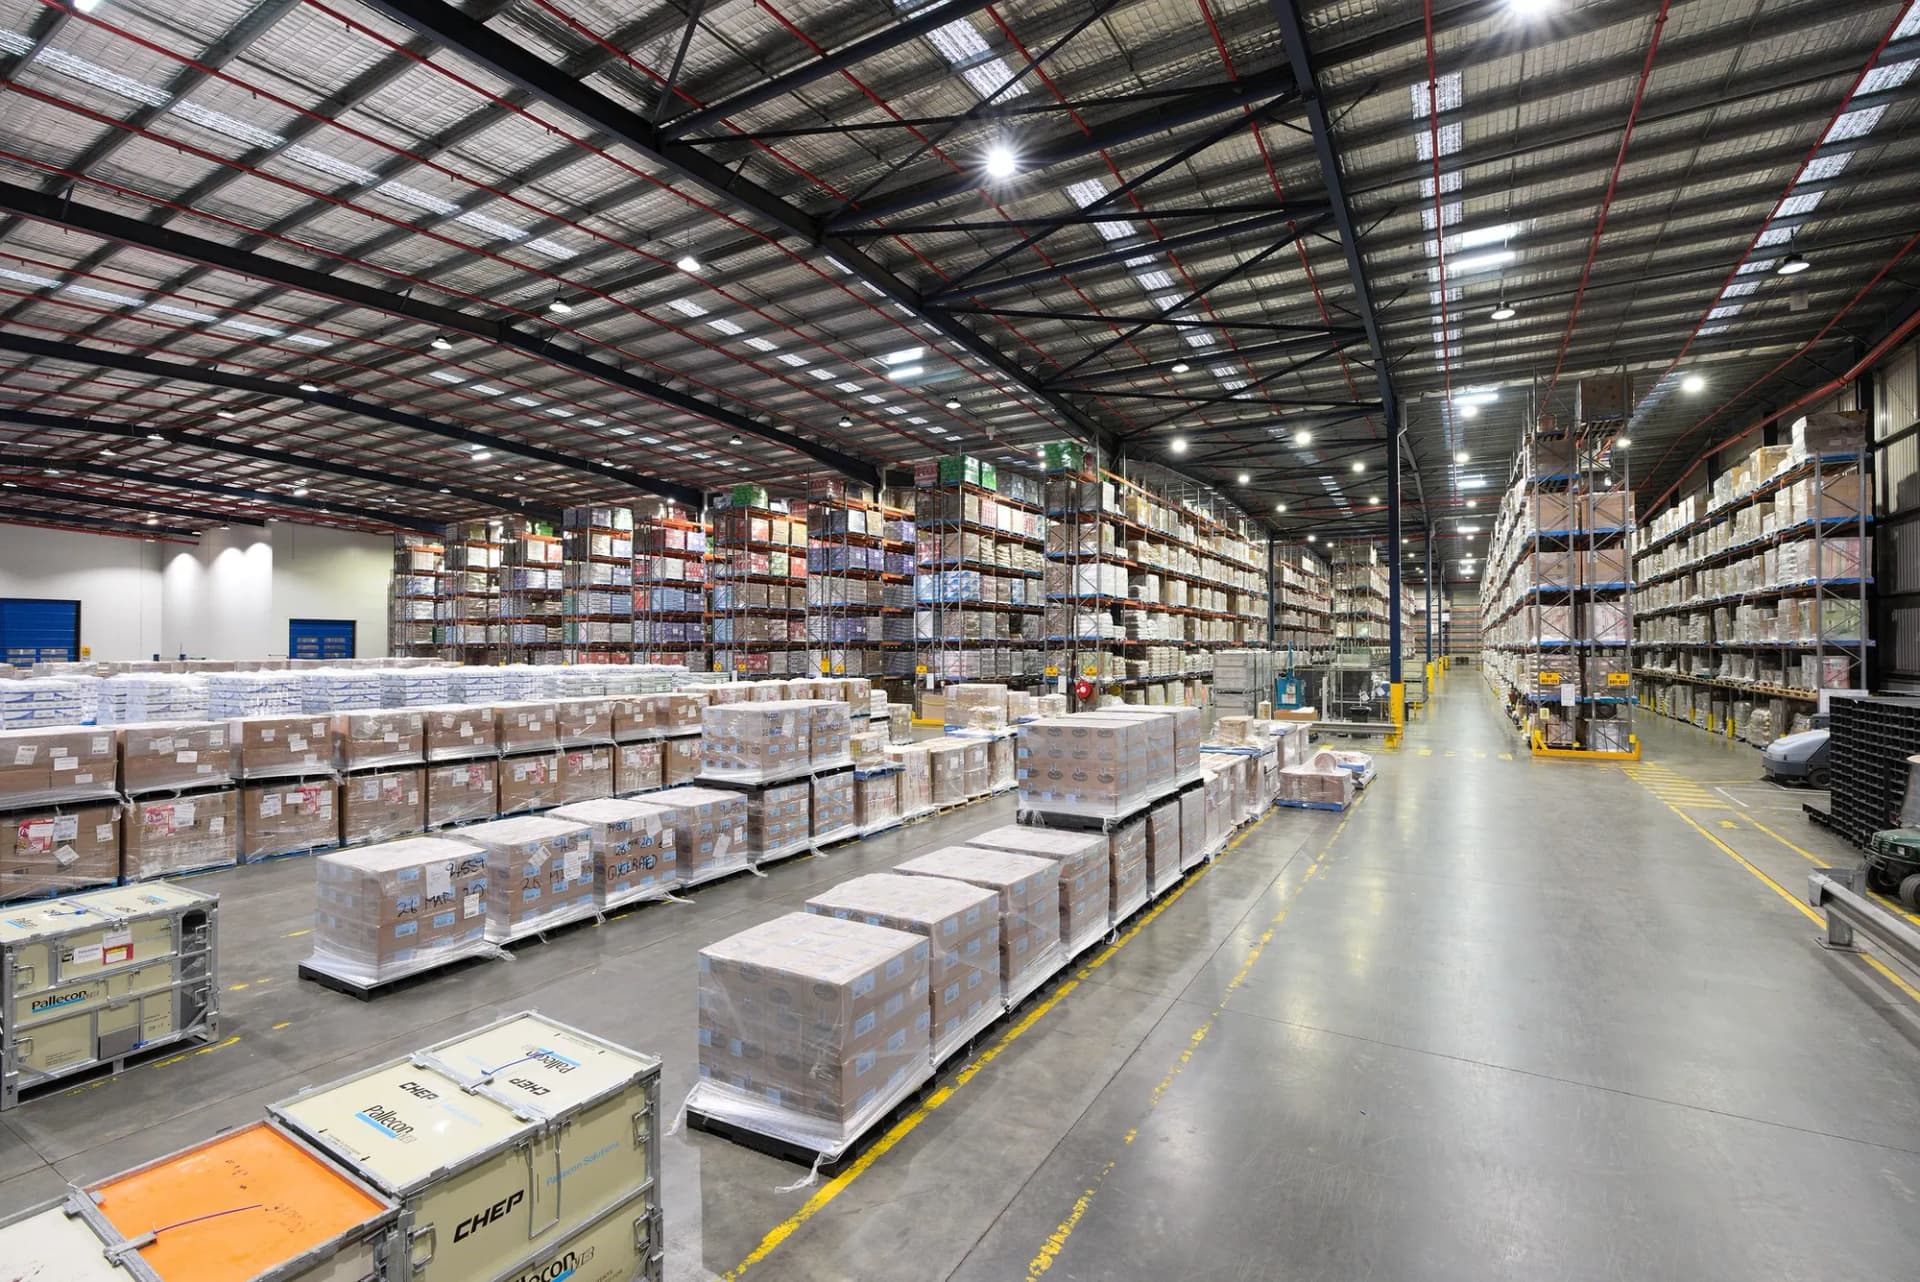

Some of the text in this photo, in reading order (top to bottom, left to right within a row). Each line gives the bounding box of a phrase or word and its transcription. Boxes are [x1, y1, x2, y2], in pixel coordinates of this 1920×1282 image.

[32, 990, 88, 1010] Pallecon
[399, 1081, 439, 1100] CHEP
[509, 1078, 551, 1096] CHEP
[363, 1104, 415, 1135] Pallecon
[453, 1190, 525, 1243] CHEP
